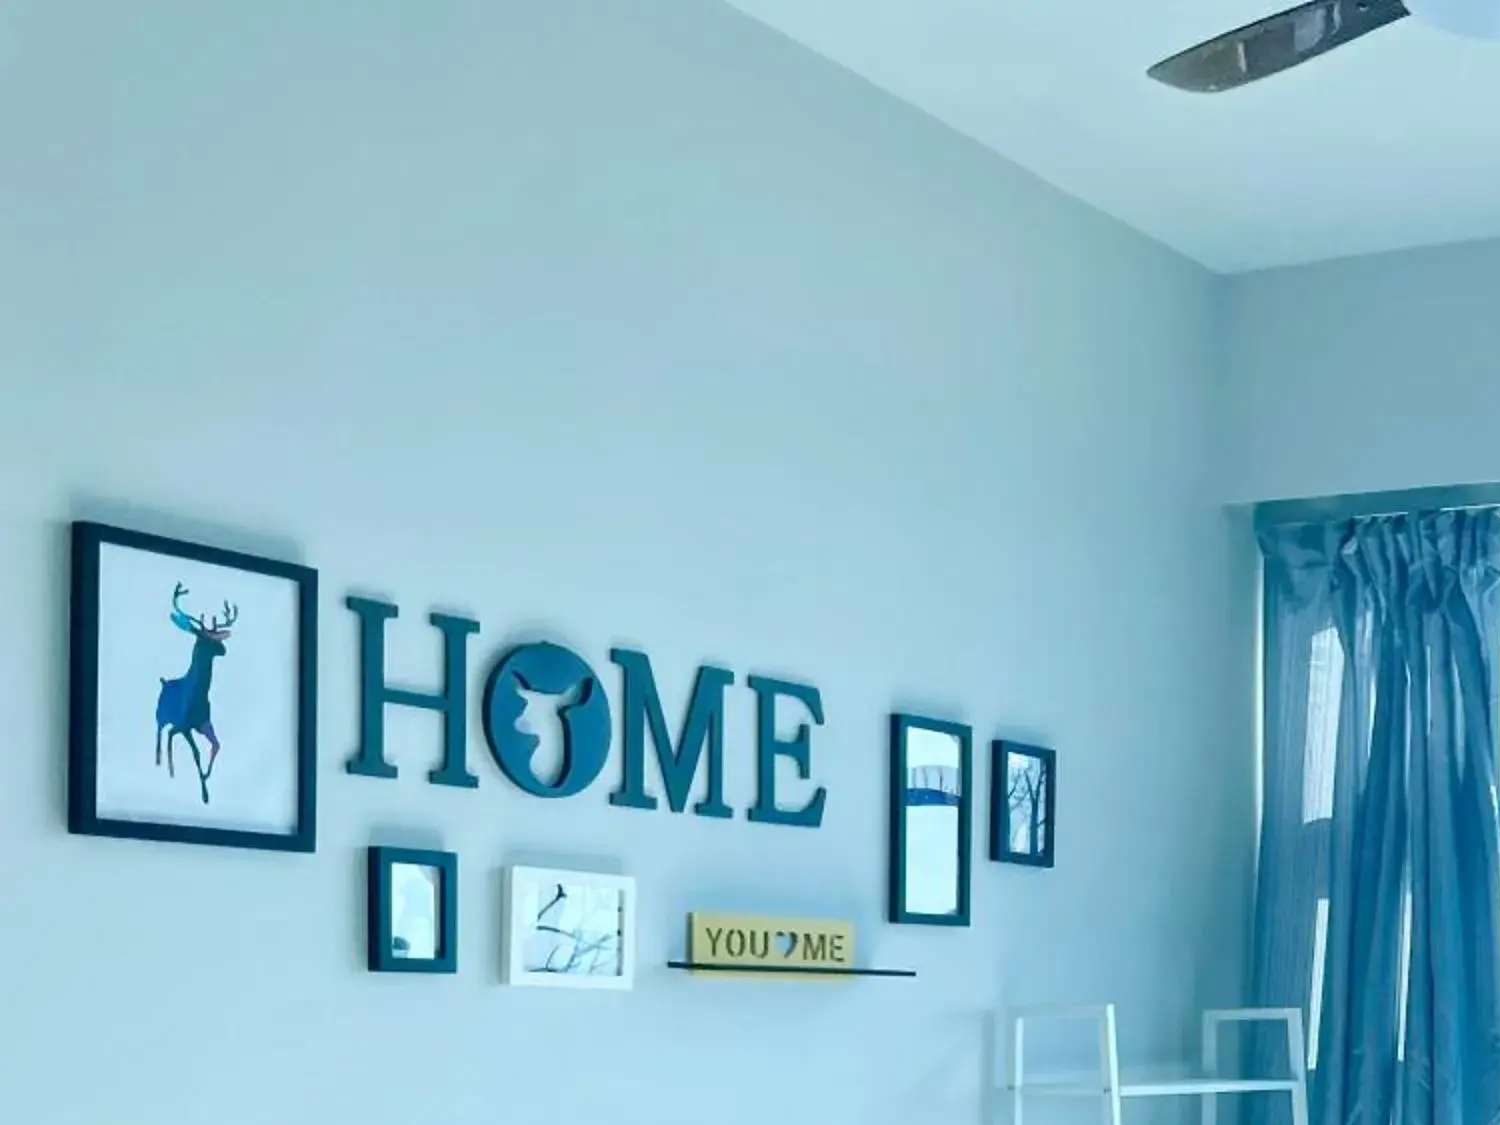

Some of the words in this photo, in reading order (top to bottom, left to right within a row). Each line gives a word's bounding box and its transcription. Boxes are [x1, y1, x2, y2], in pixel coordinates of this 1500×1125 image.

[345, 595, 826, 828] HOME
[705, 927, 770, 959] YOU
[802, 932, 845, 963] ME
